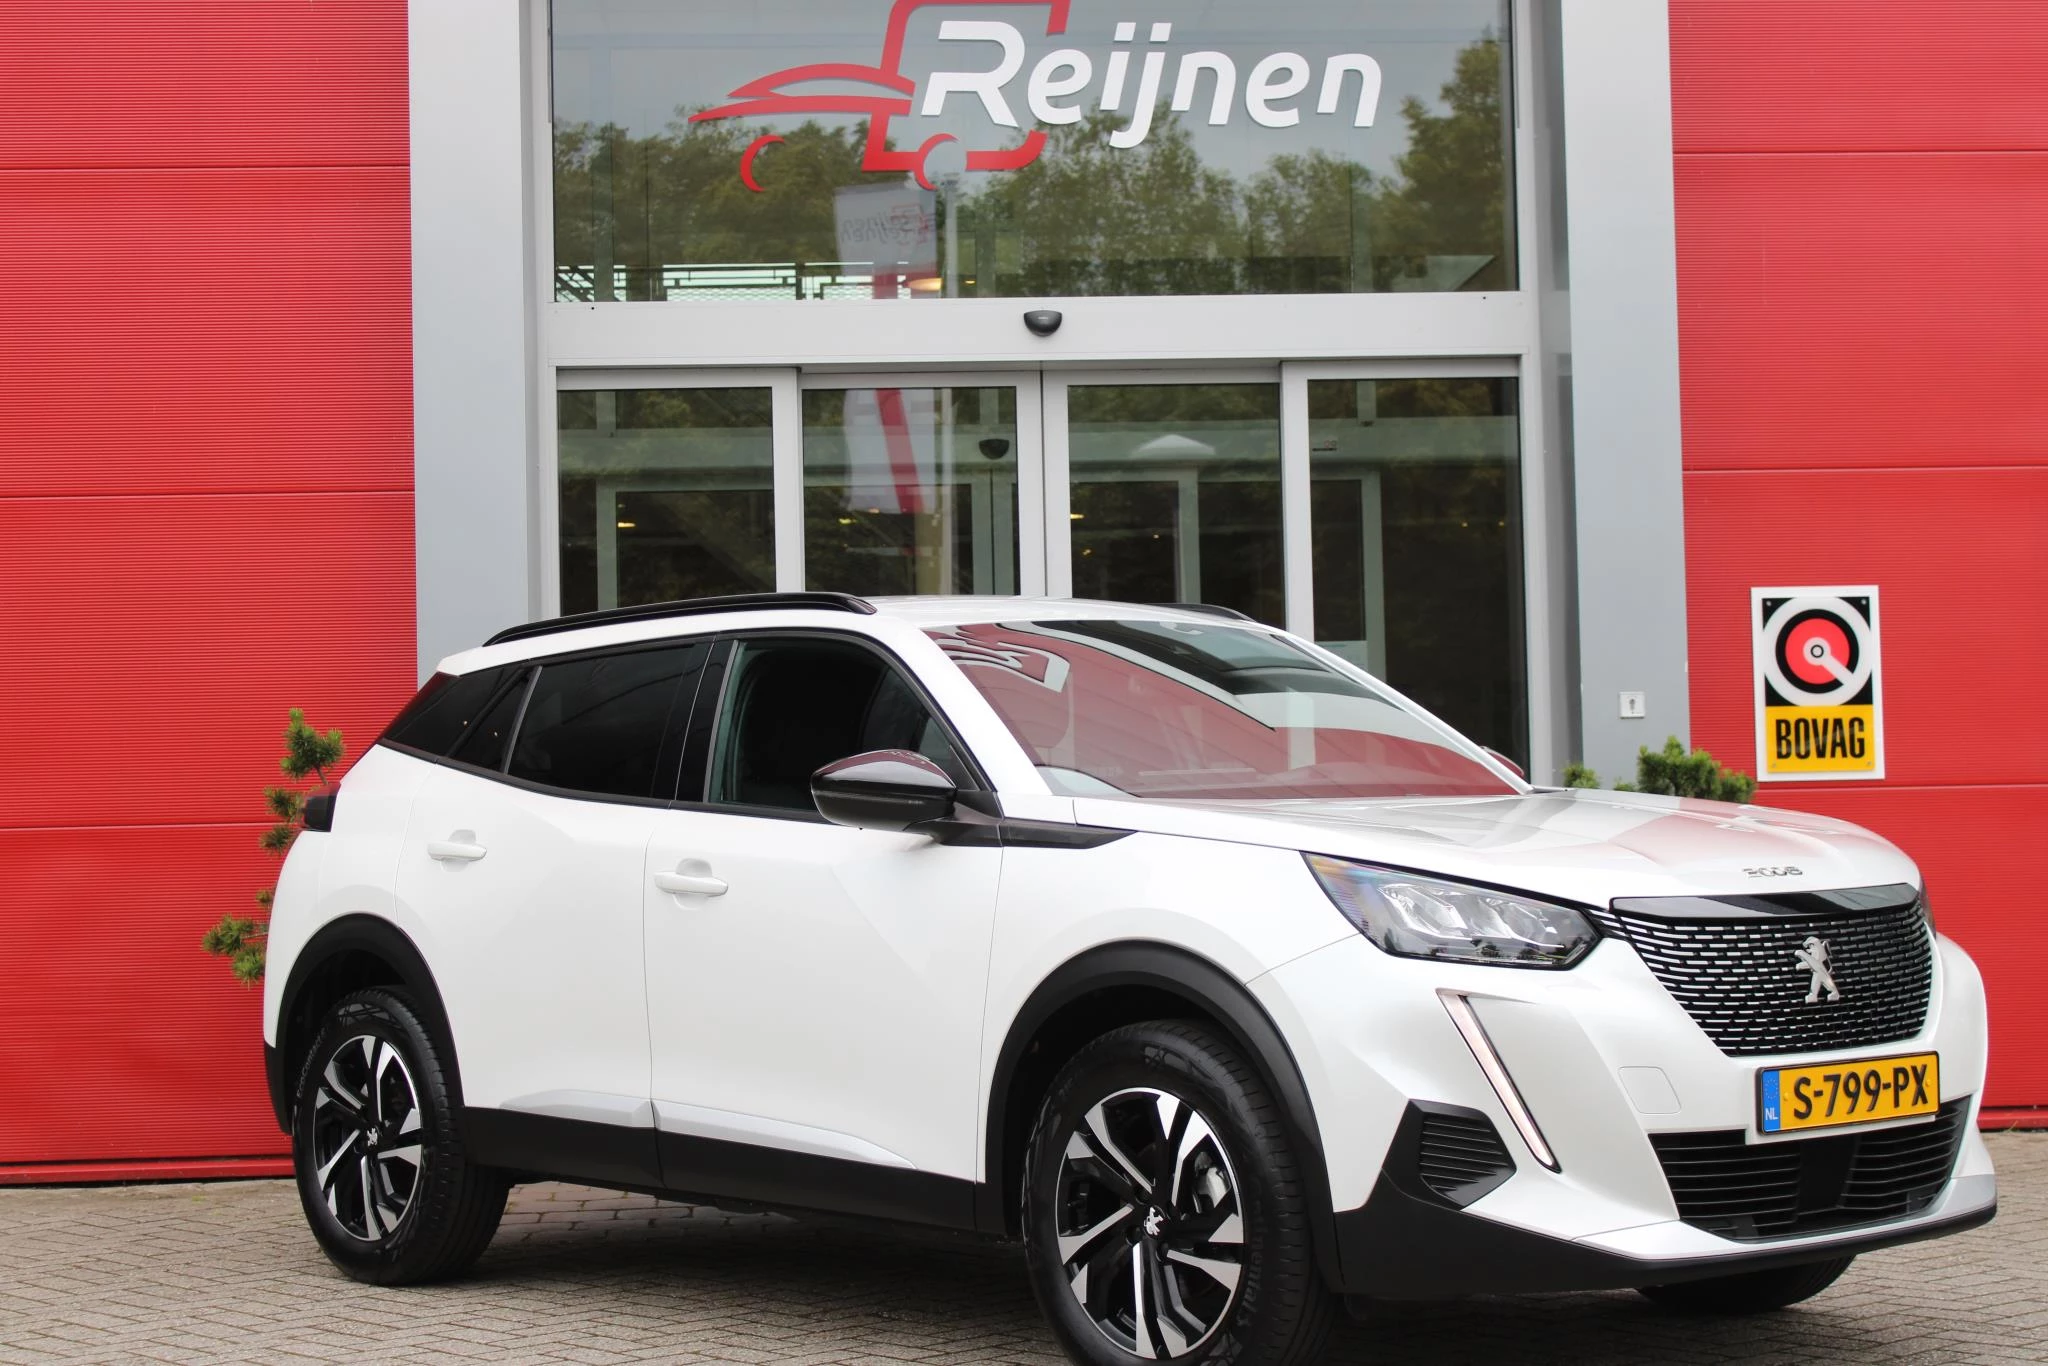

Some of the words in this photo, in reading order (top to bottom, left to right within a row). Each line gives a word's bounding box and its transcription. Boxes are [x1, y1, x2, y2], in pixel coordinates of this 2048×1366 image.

[920, 20, 1383, 149] Reijnen
[1775, 717, 1865, 760] BOVAG
[1765, 1107, 1778, 1120] NL
[1793, 1064, 1929, 1120] S-799-PX
